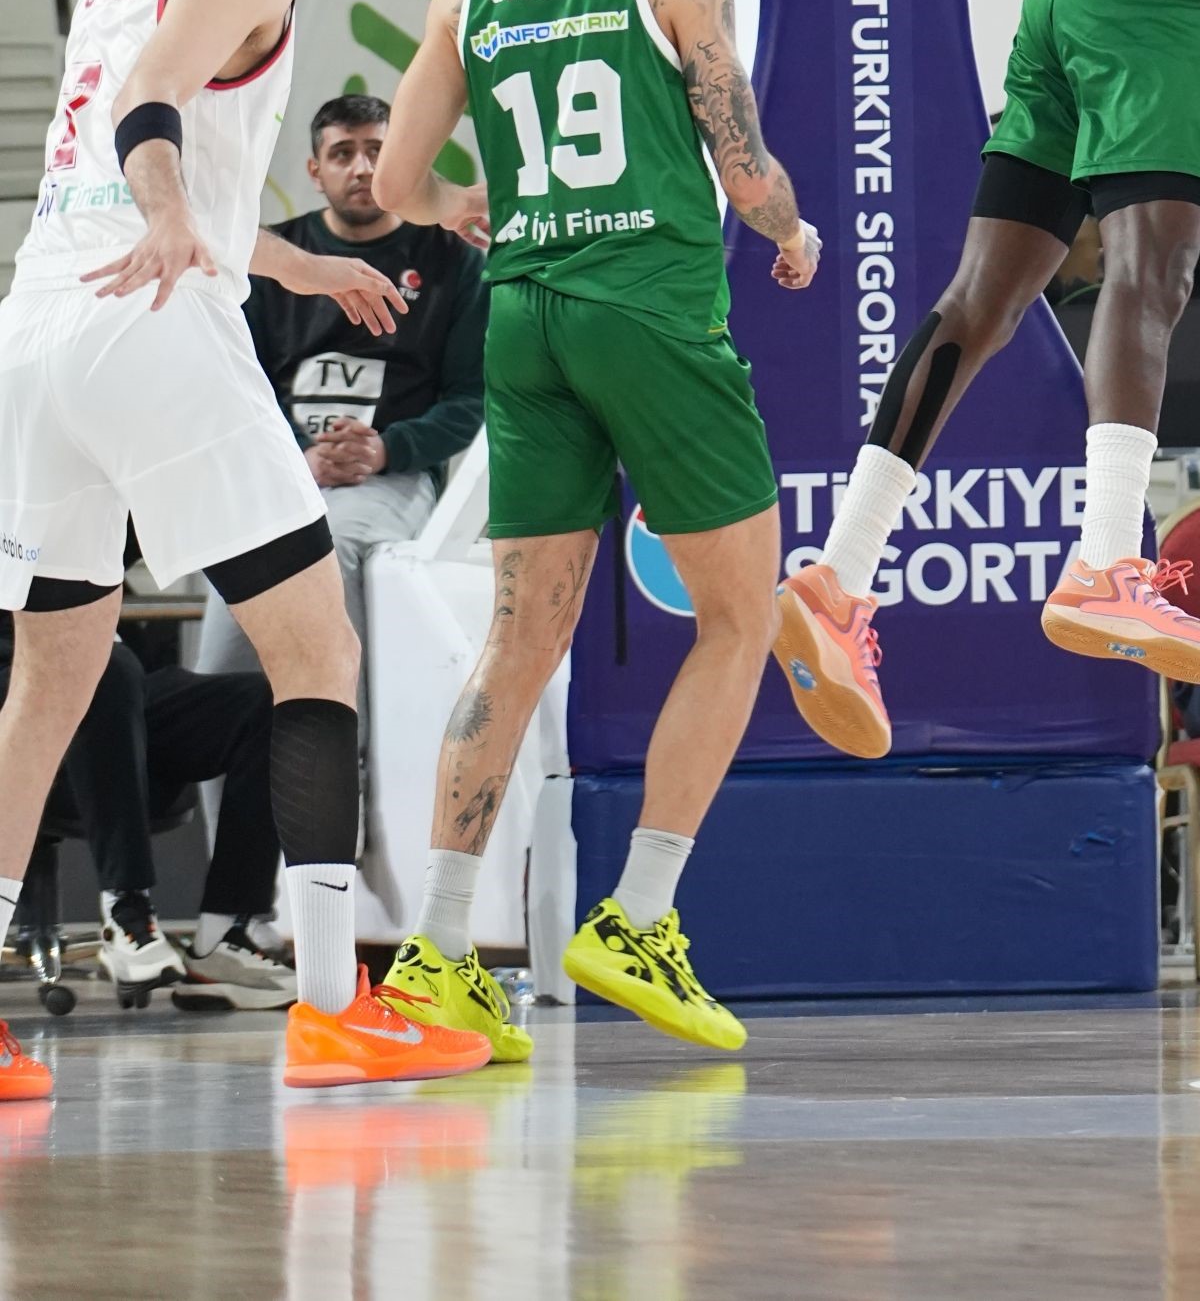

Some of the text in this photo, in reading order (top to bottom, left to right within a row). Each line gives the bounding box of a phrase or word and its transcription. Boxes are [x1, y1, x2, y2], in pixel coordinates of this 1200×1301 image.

[491, 58, 628, 198] 19
[565, 207, 656, 237] Finans
[315, 359, 367, 388] TV
[781, 466, 1088, 533] TRKİYE
